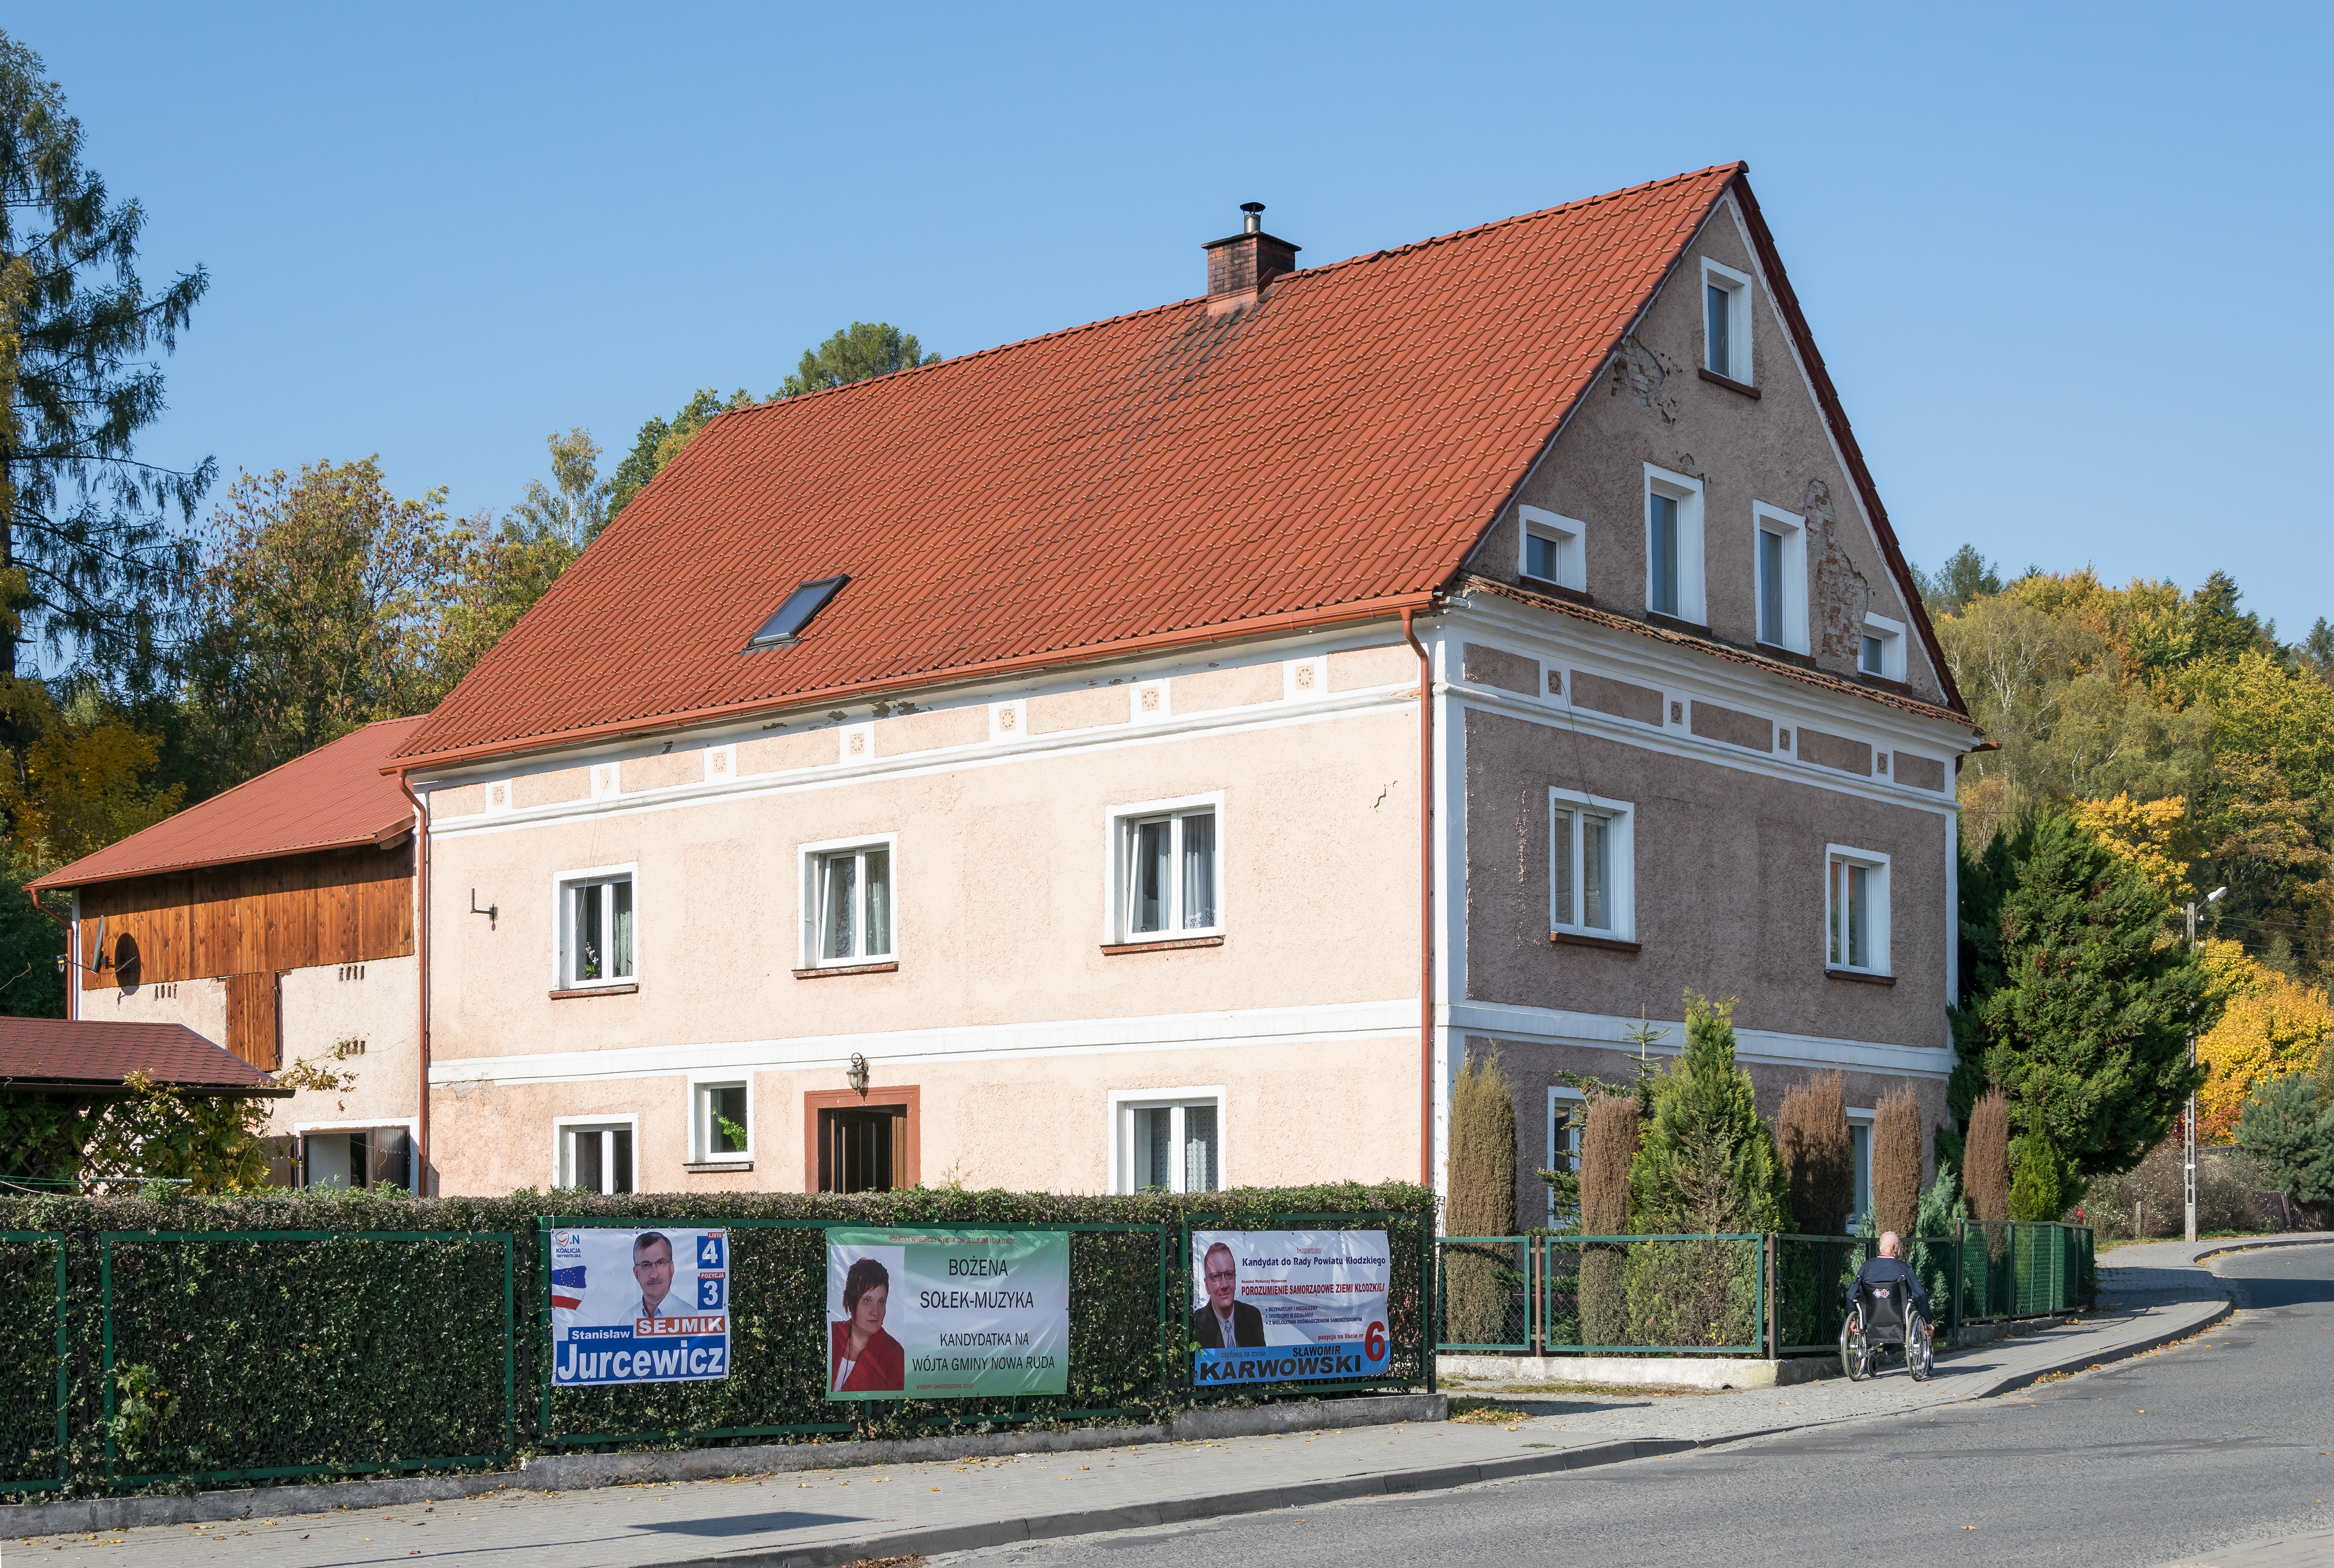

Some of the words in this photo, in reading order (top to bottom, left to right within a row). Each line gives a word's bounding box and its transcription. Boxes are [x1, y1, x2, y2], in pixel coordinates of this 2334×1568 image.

[702, 1240, 718, 1264] 4
[949, 1255, 1008, 1276] BOŻENA
[1242, 1258, 1279, 1268] Kandydat
[1294, 1257, 1311, 1267] Rady
[1314, 1257, 1343, 1265] Powiatu
[1346, 1256, 1385, 1266] Kłodzkiego
[703, 1281, 718, 1305] 3
[1241, 1285, 1288, 1296] POROZUMIENIE
[1289, 1285, 1334, 1296] SAMORZĄDOWE
[1336, 1284, 1353, 1293] ZIEMI
[1355, 1283, 1385, 1292] KŁODZKIEJ
[920, 1291, 1034, 1308] SOŁEK-MUZYKA
[572, 1329, 630, 1340] Stanisław
[639, 1318, 723, 1334] SEJMIK
[940, 1333, 1012, 1346] KANDYDATKA
[1015, 1333, 1029, 1345] NA
[1365, 1321, 1385, 1362] 6
[1221, 1350, 1243, 1360] zagłosuj
[1293, 1345, 1341, 1357] SŁAWOMIR
[558, 1340, 723, 1380] Jurcewicz
[912, 1355, 948, 1372] WÓJTA
[951, 1357, 988, 1371] GMINY
[991, 1356, 1023, 1369] NOWA
[1026, 1356, 1055, 1369] RUDA
[1200, 1355, 1361, 1381] KARWOWSKI
